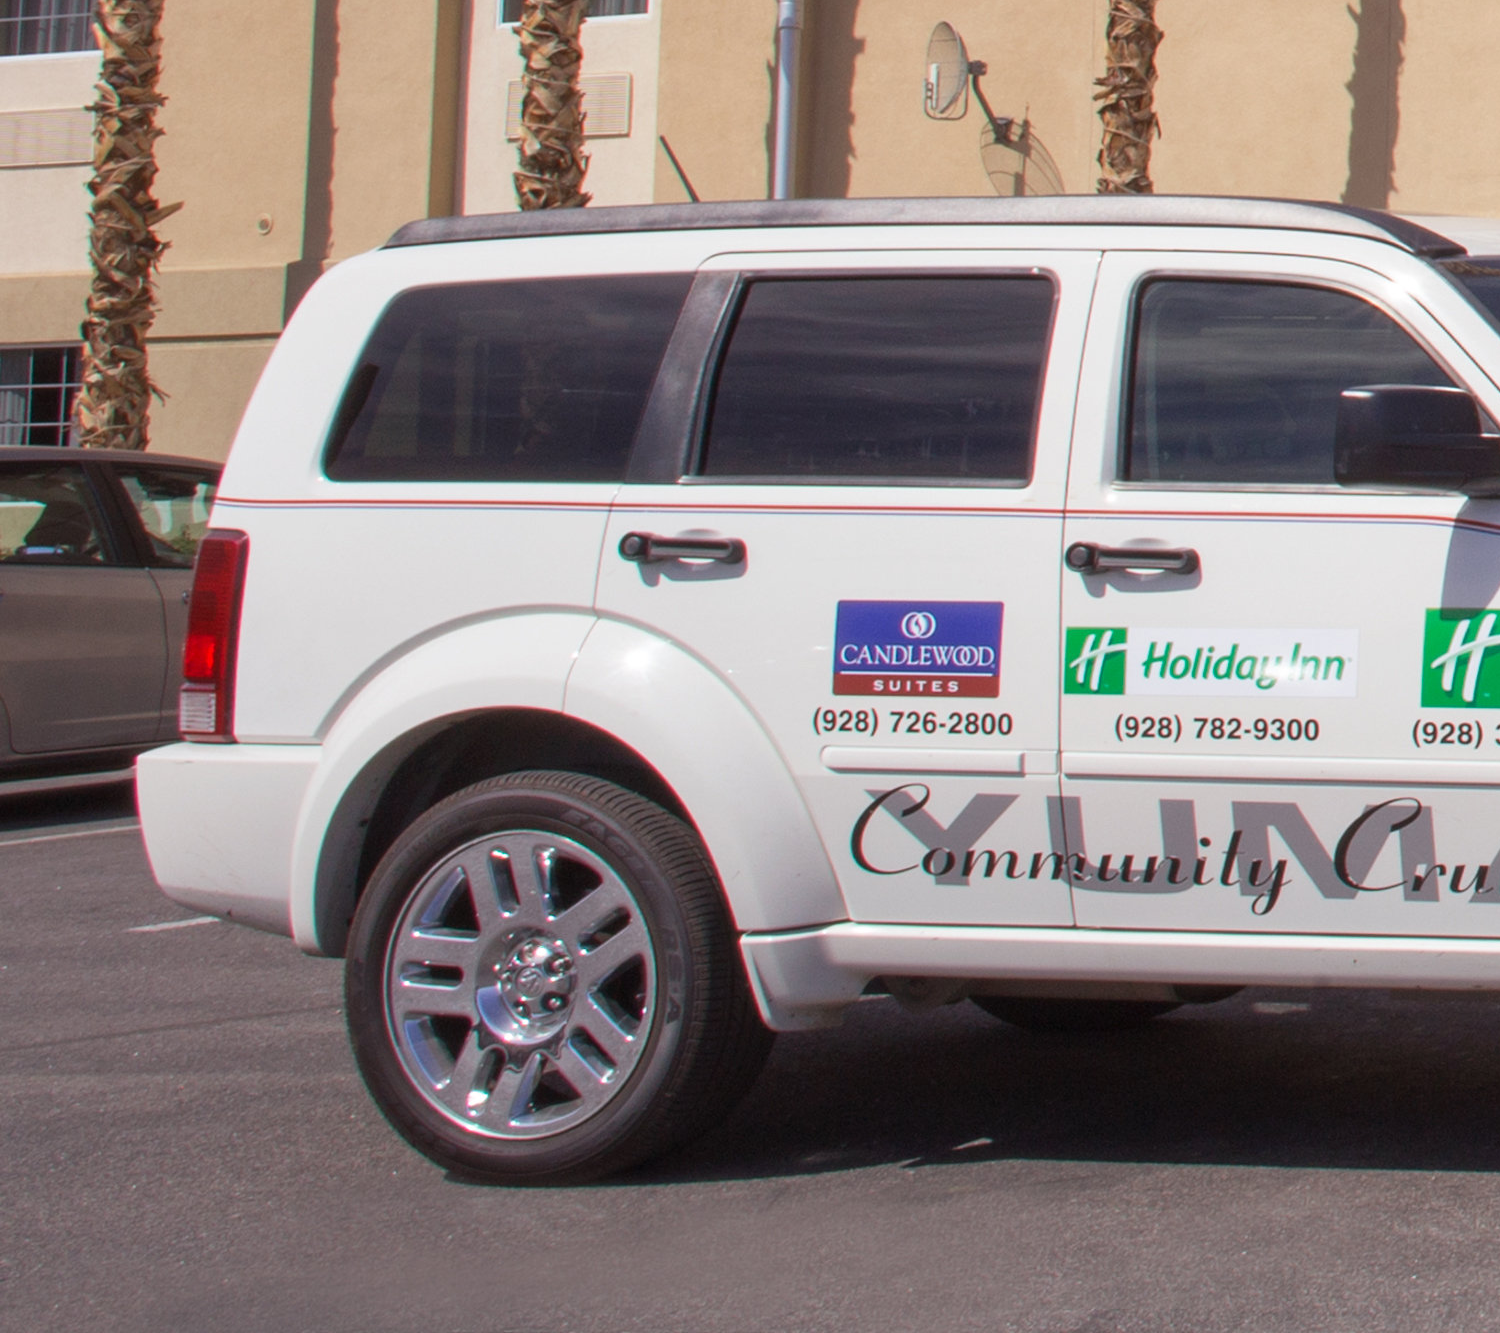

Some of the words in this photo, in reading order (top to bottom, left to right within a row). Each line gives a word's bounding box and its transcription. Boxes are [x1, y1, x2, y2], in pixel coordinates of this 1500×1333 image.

[840, 644, 995, 667] CANDLEWOOD
[1142, 641, 1282, 690] Holiday
[1290, 642, 1347, 681] Inn
[873, 679, 960, 693] SUITES
[813, 706, 879, 736] (928)
[889, 711, 1013, 735] 726-2800
[1115, 714, 1182, 743] (928)
[1193, 717, 1320, 741] 782-9300
[1412, 719, 1483, 749] (928)
[850, 783, 1292, 916] Community
